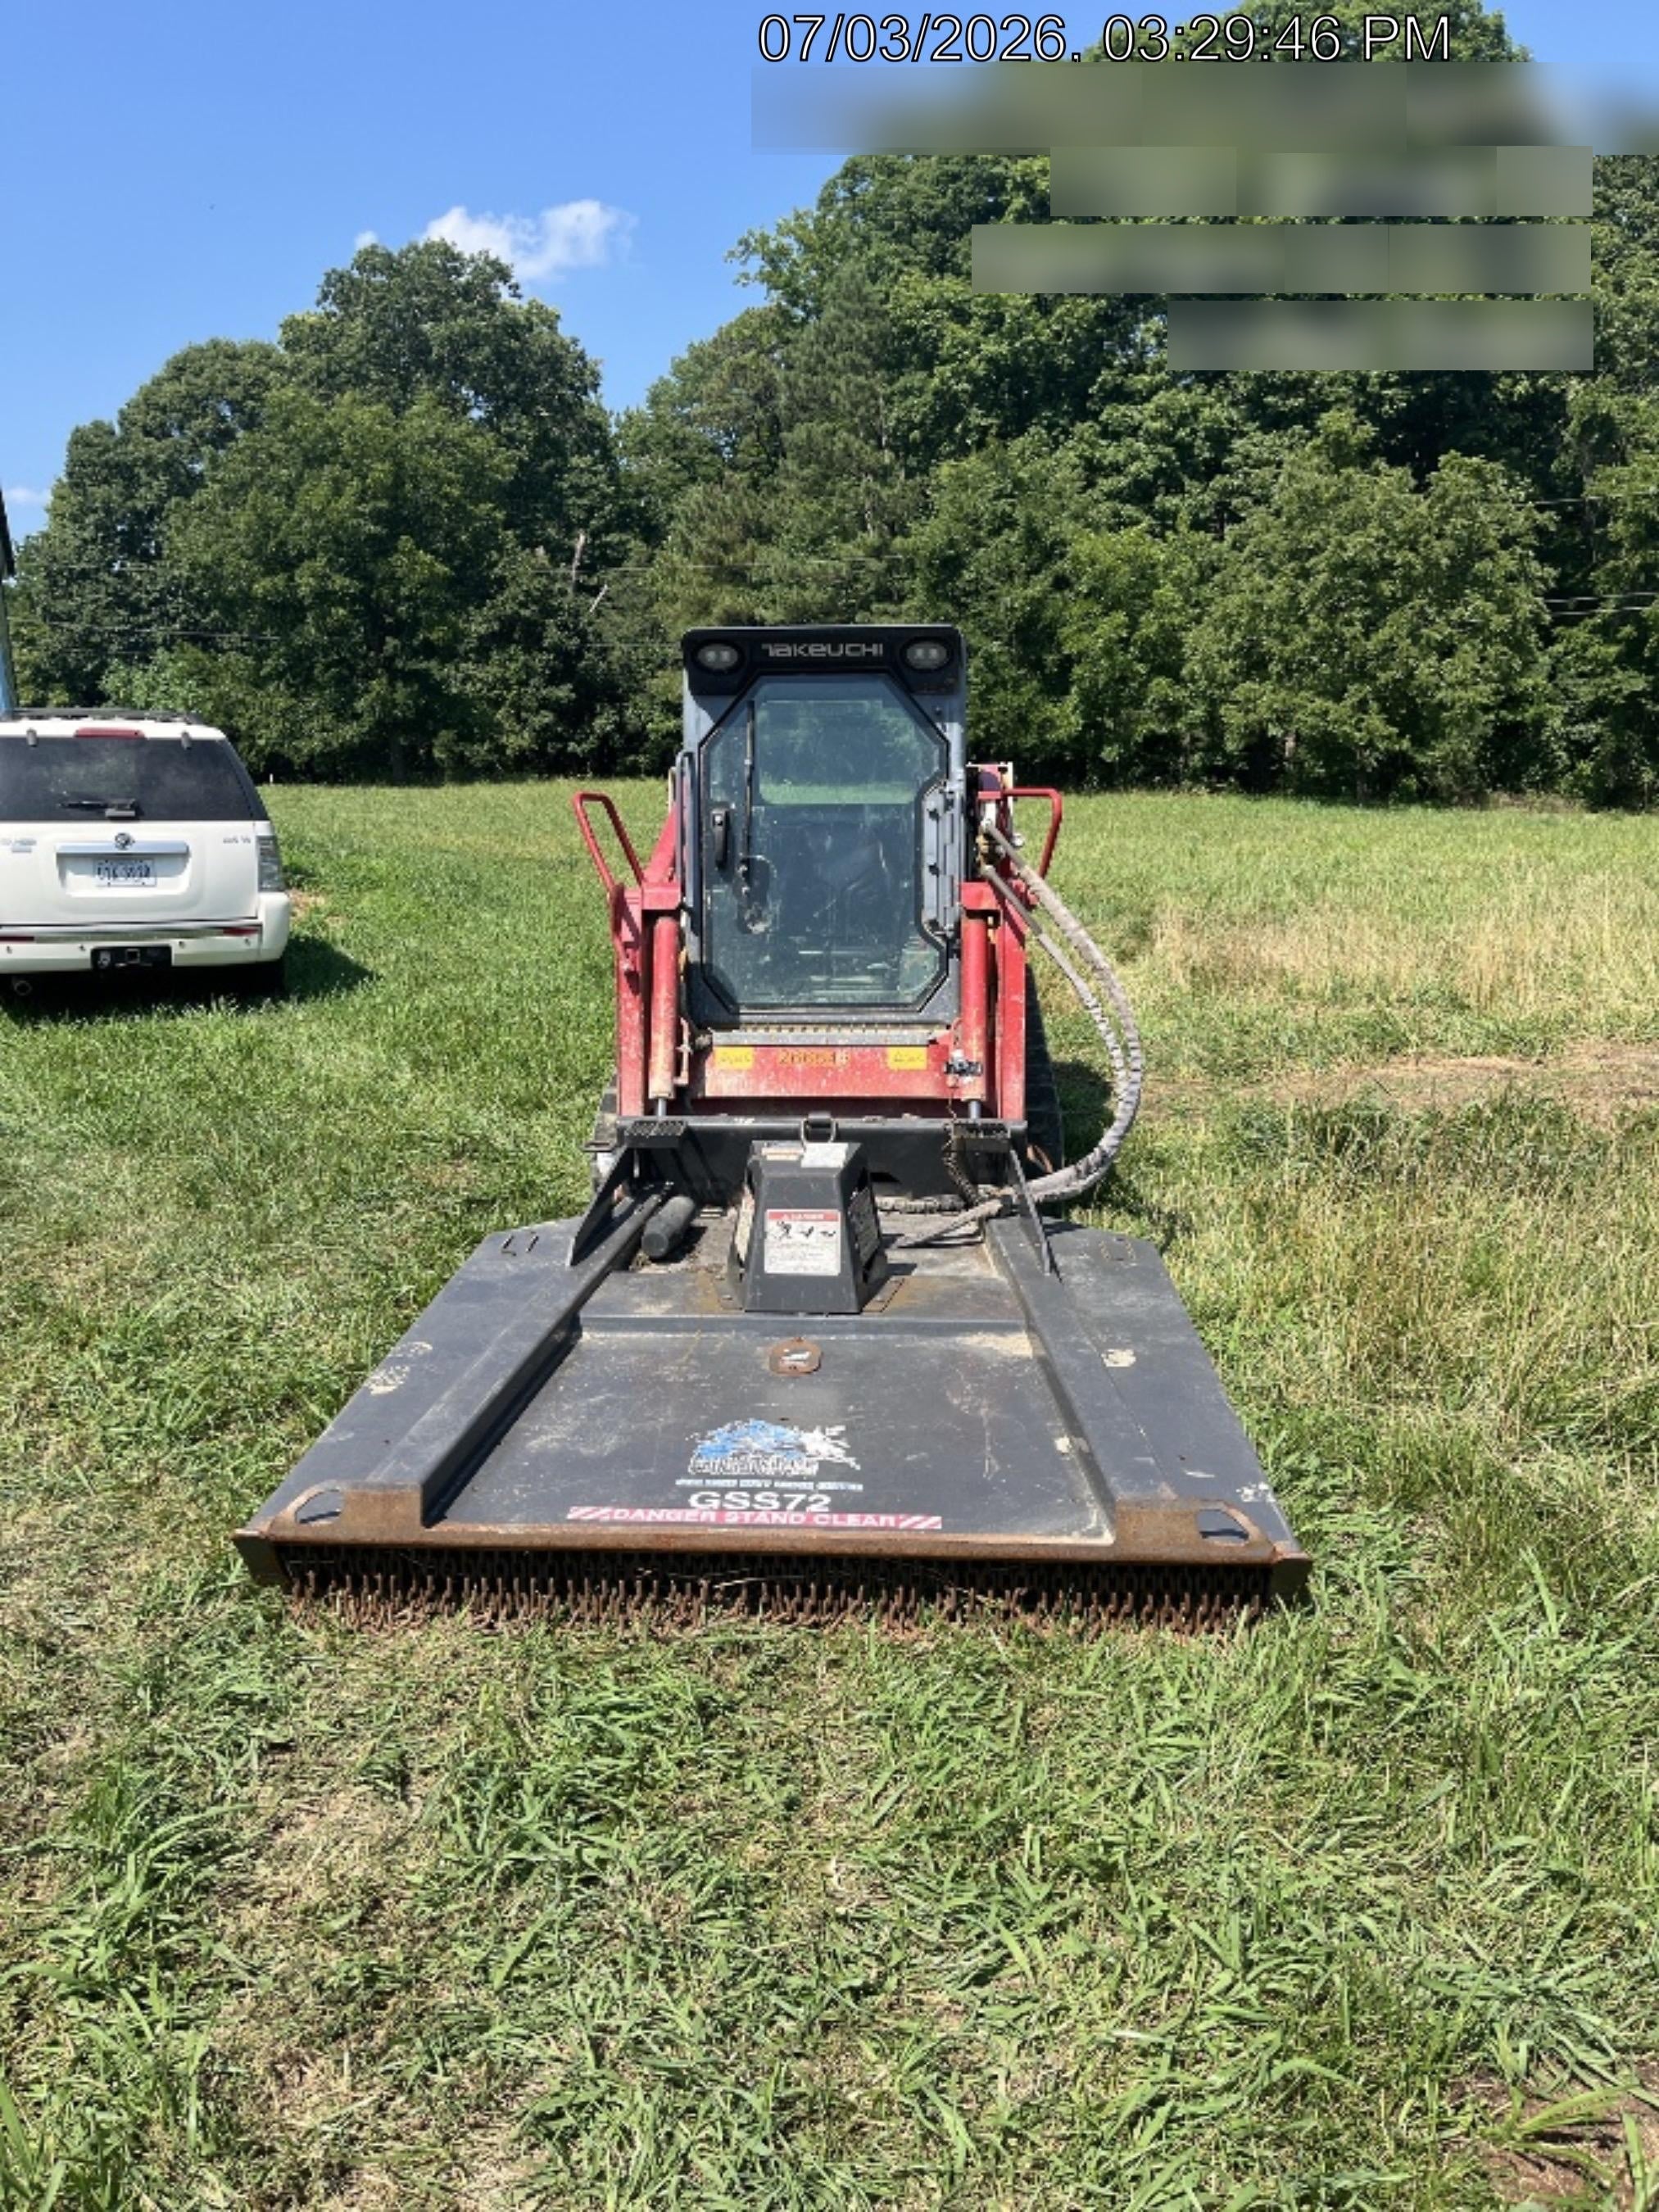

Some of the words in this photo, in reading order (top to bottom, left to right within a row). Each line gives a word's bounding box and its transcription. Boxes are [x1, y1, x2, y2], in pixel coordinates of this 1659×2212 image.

[688, 1491, 832, 1512] GSS72
[614, 1508, 716, 1522] DANGER
[724, 1511, 806, 1525] STAND
[814, 1513, 896, 1527] CLEAR
